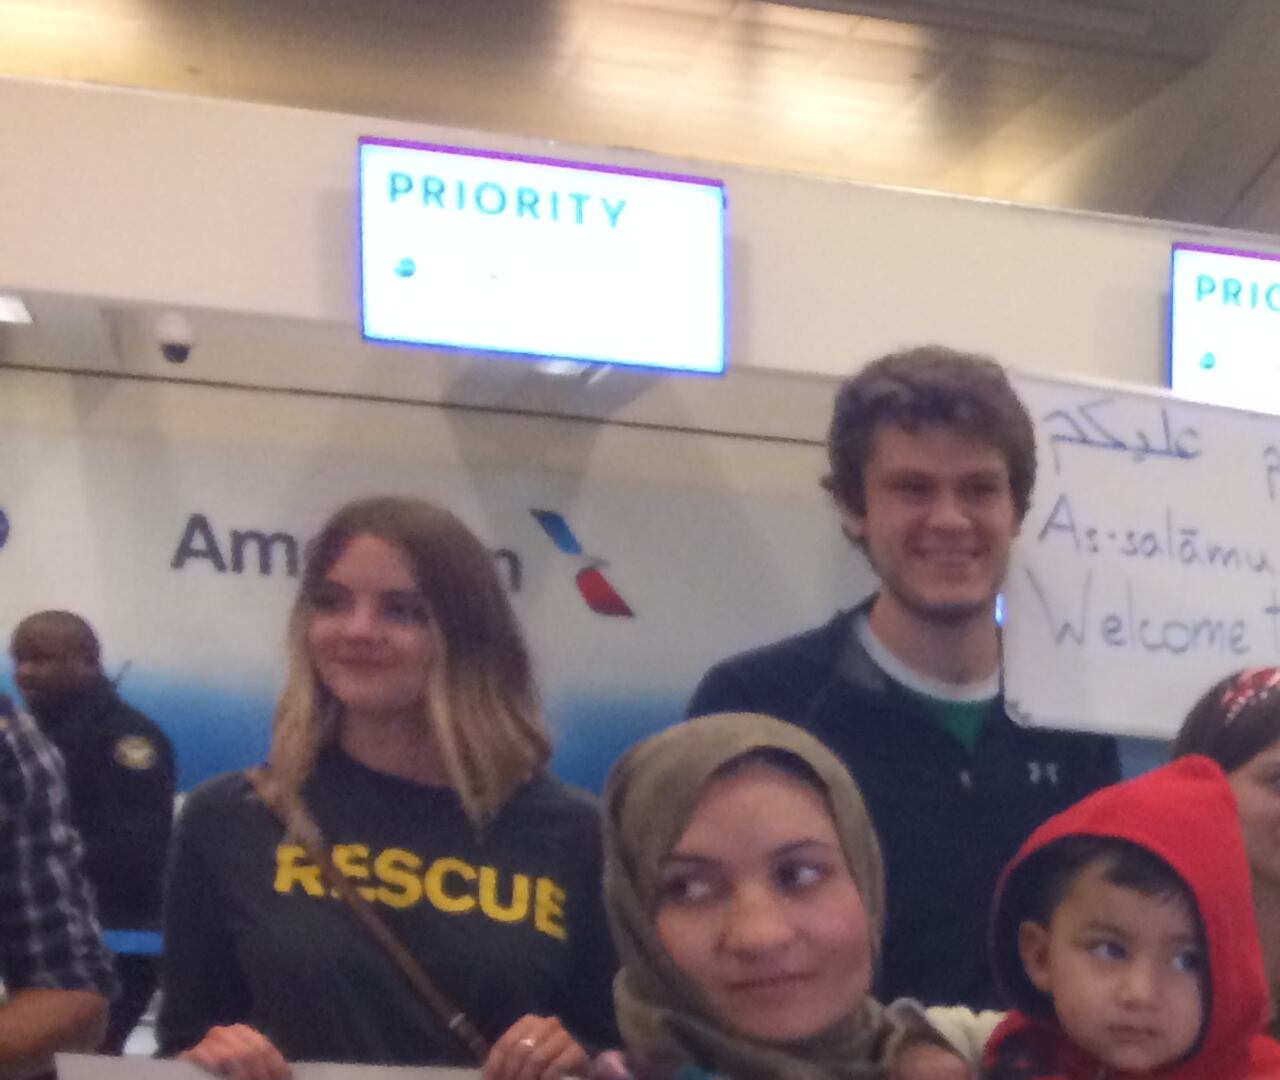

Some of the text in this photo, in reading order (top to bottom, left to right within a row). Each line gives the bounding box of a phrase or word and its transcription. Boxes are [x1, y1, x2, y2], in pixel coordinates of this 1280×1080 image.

[386, 170, 627, 229] PRIORITY
[1025, 568, 1250, 656] Welcome
[273, 842, 569, 942] RESCUE
